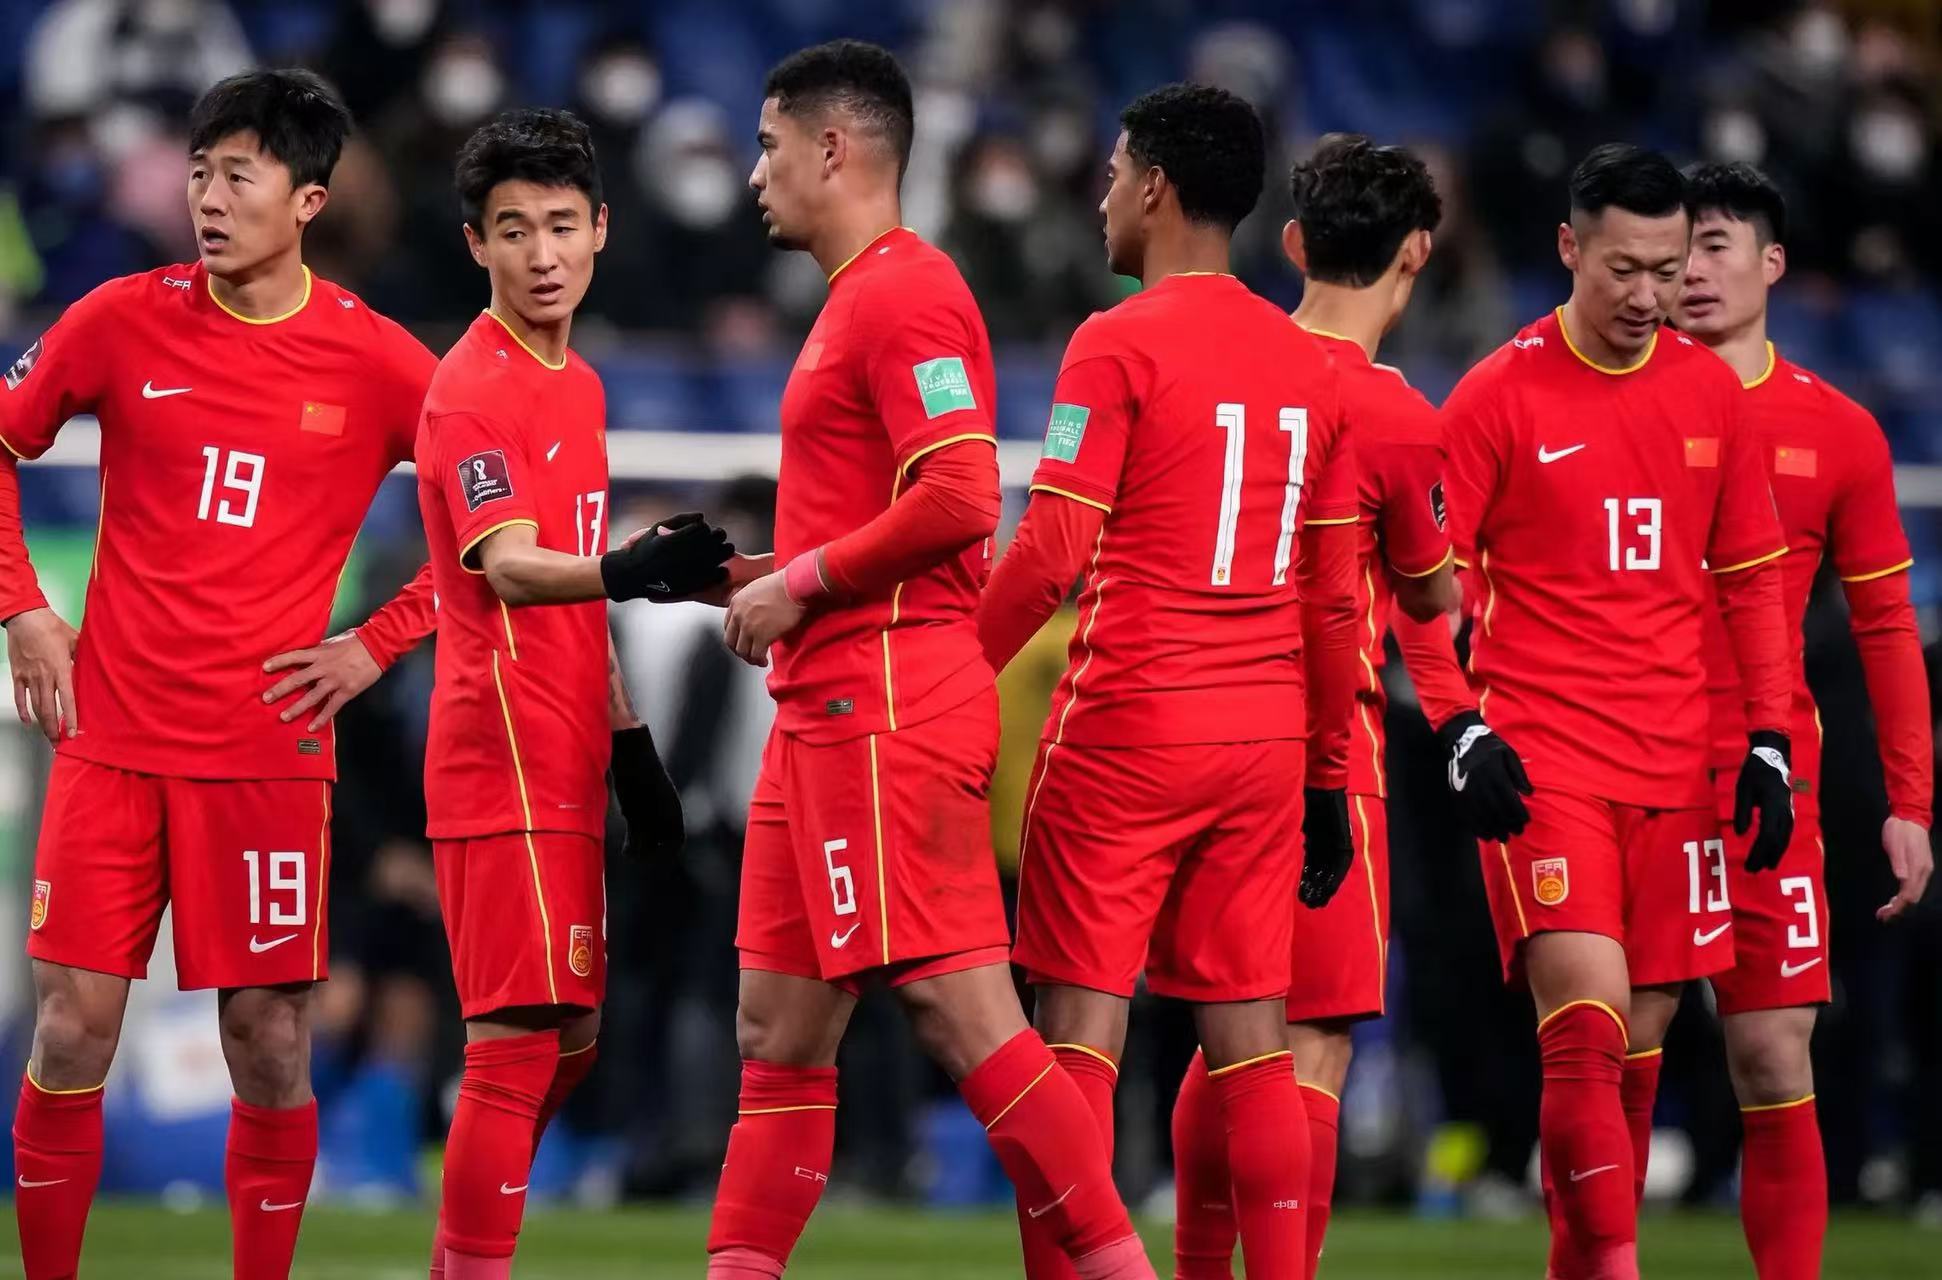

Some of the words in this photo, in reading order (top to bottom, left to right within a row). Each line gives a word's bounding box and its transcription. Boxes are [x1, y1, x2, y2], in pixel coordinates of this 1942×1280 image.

[163, 276, 191, 290] CFA
[198, 446, 265, 528] 19
[1211, 402, 1307, 586] 11
[1604, 498, 1662, 571] 13
[243, 851, 306, 925] 19
[824, 838, 857, 916] 6
[1535, 862, 1563, 873] CFA
[1683, 839, 1731, 913] 13
[1780, 876, 1819, 948] 3
[1273, 1199, 1298, 1209] 中国
